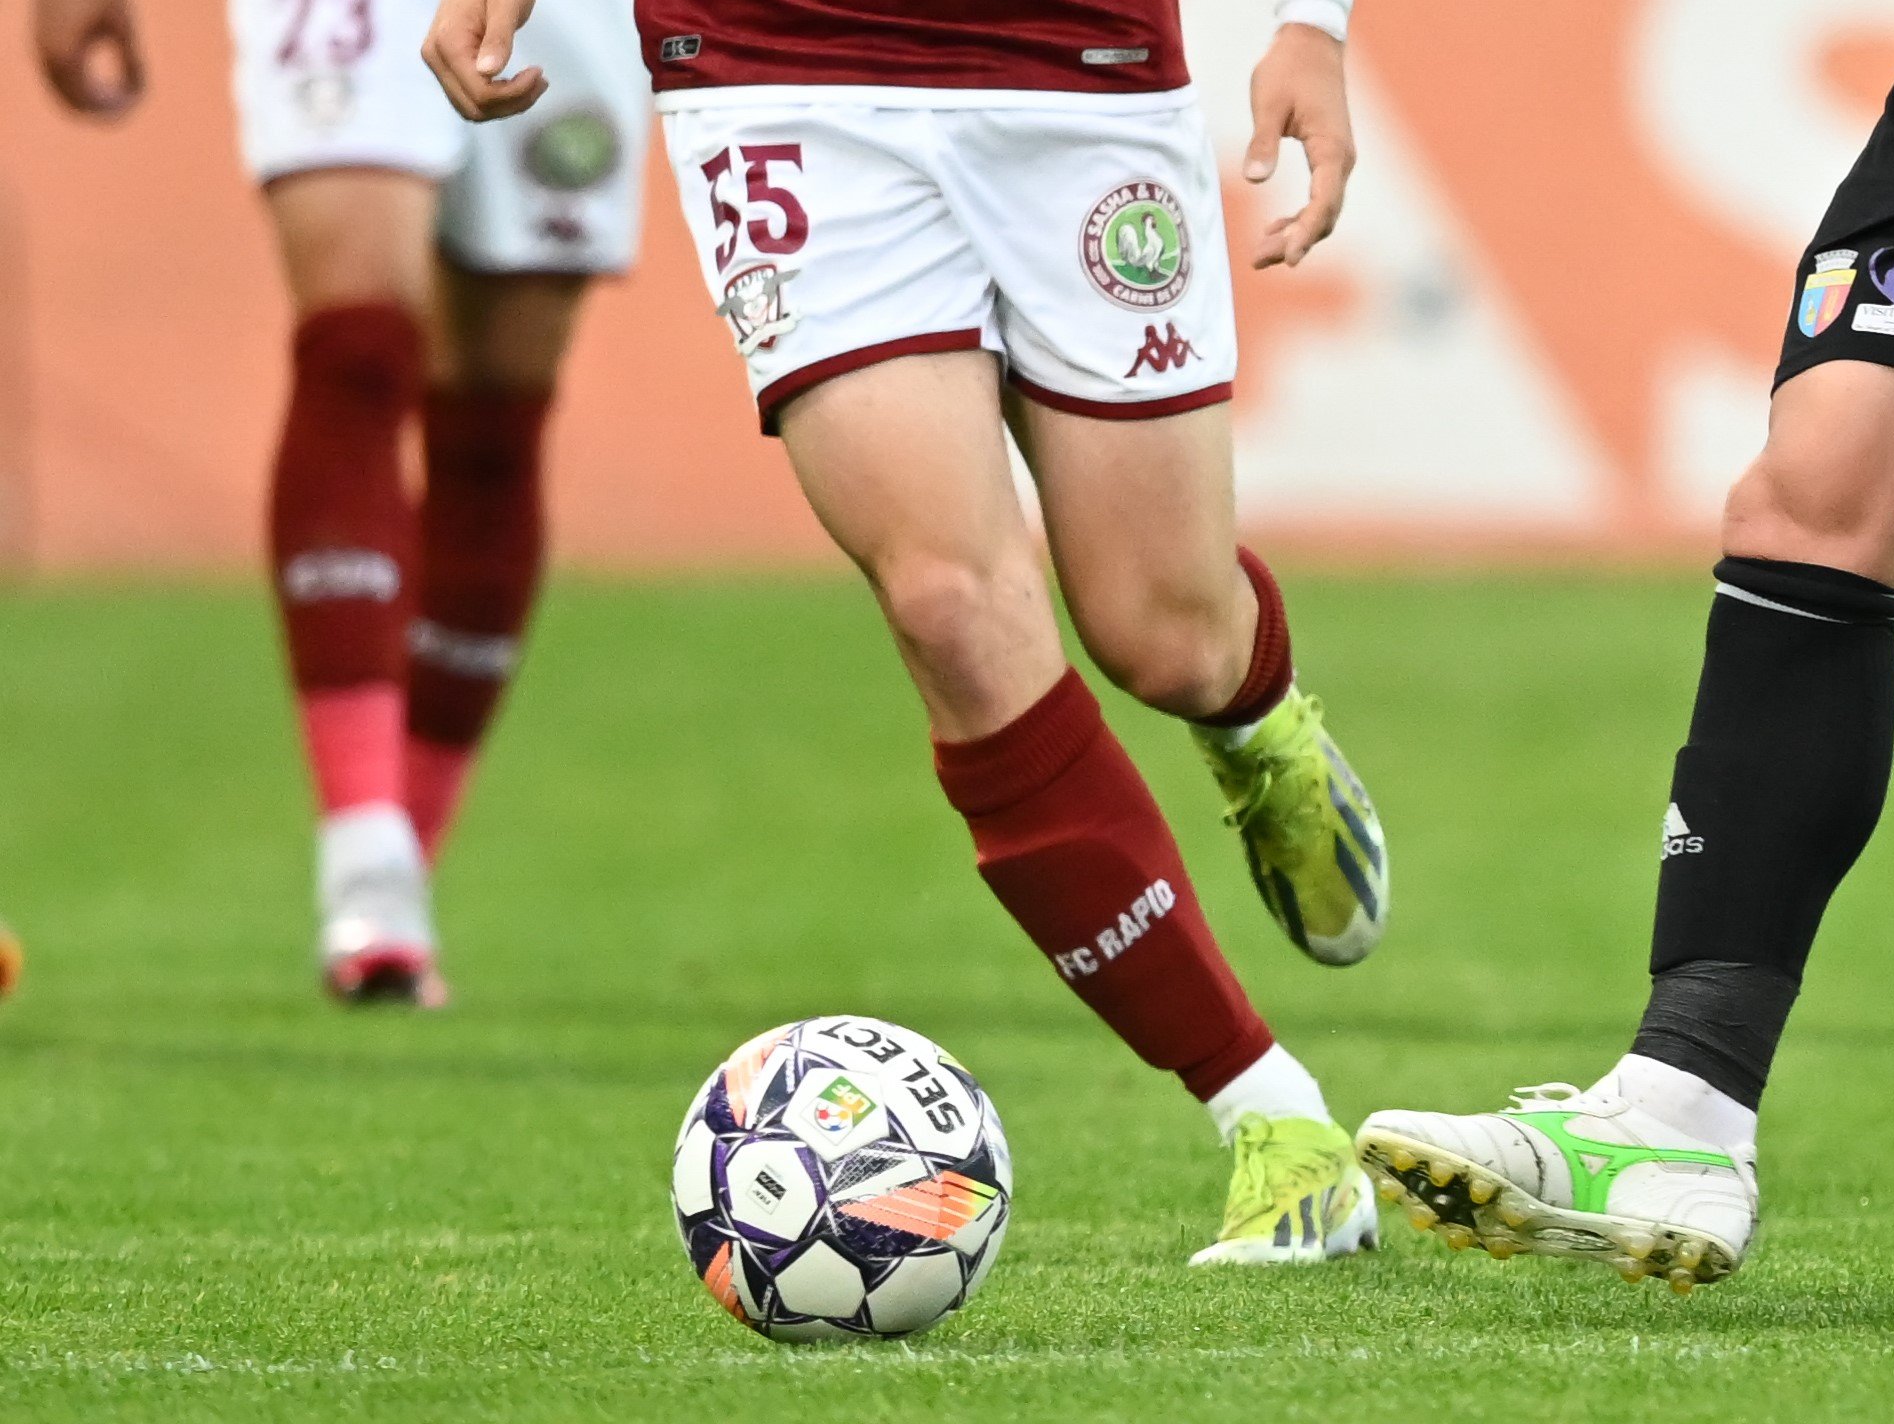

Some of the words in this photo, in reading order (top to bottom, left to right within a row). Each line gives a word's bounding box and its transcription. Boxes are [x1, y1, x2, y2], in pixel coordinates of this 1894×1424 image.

[700, 141, 810, 275] 55
[1055, 946, 1099, 980] FC
[1096, 878, 1176, 961] RAPID
[818, 1020, 966, 1136] SELECT
[831, 1082, 872, 1116] LPF
